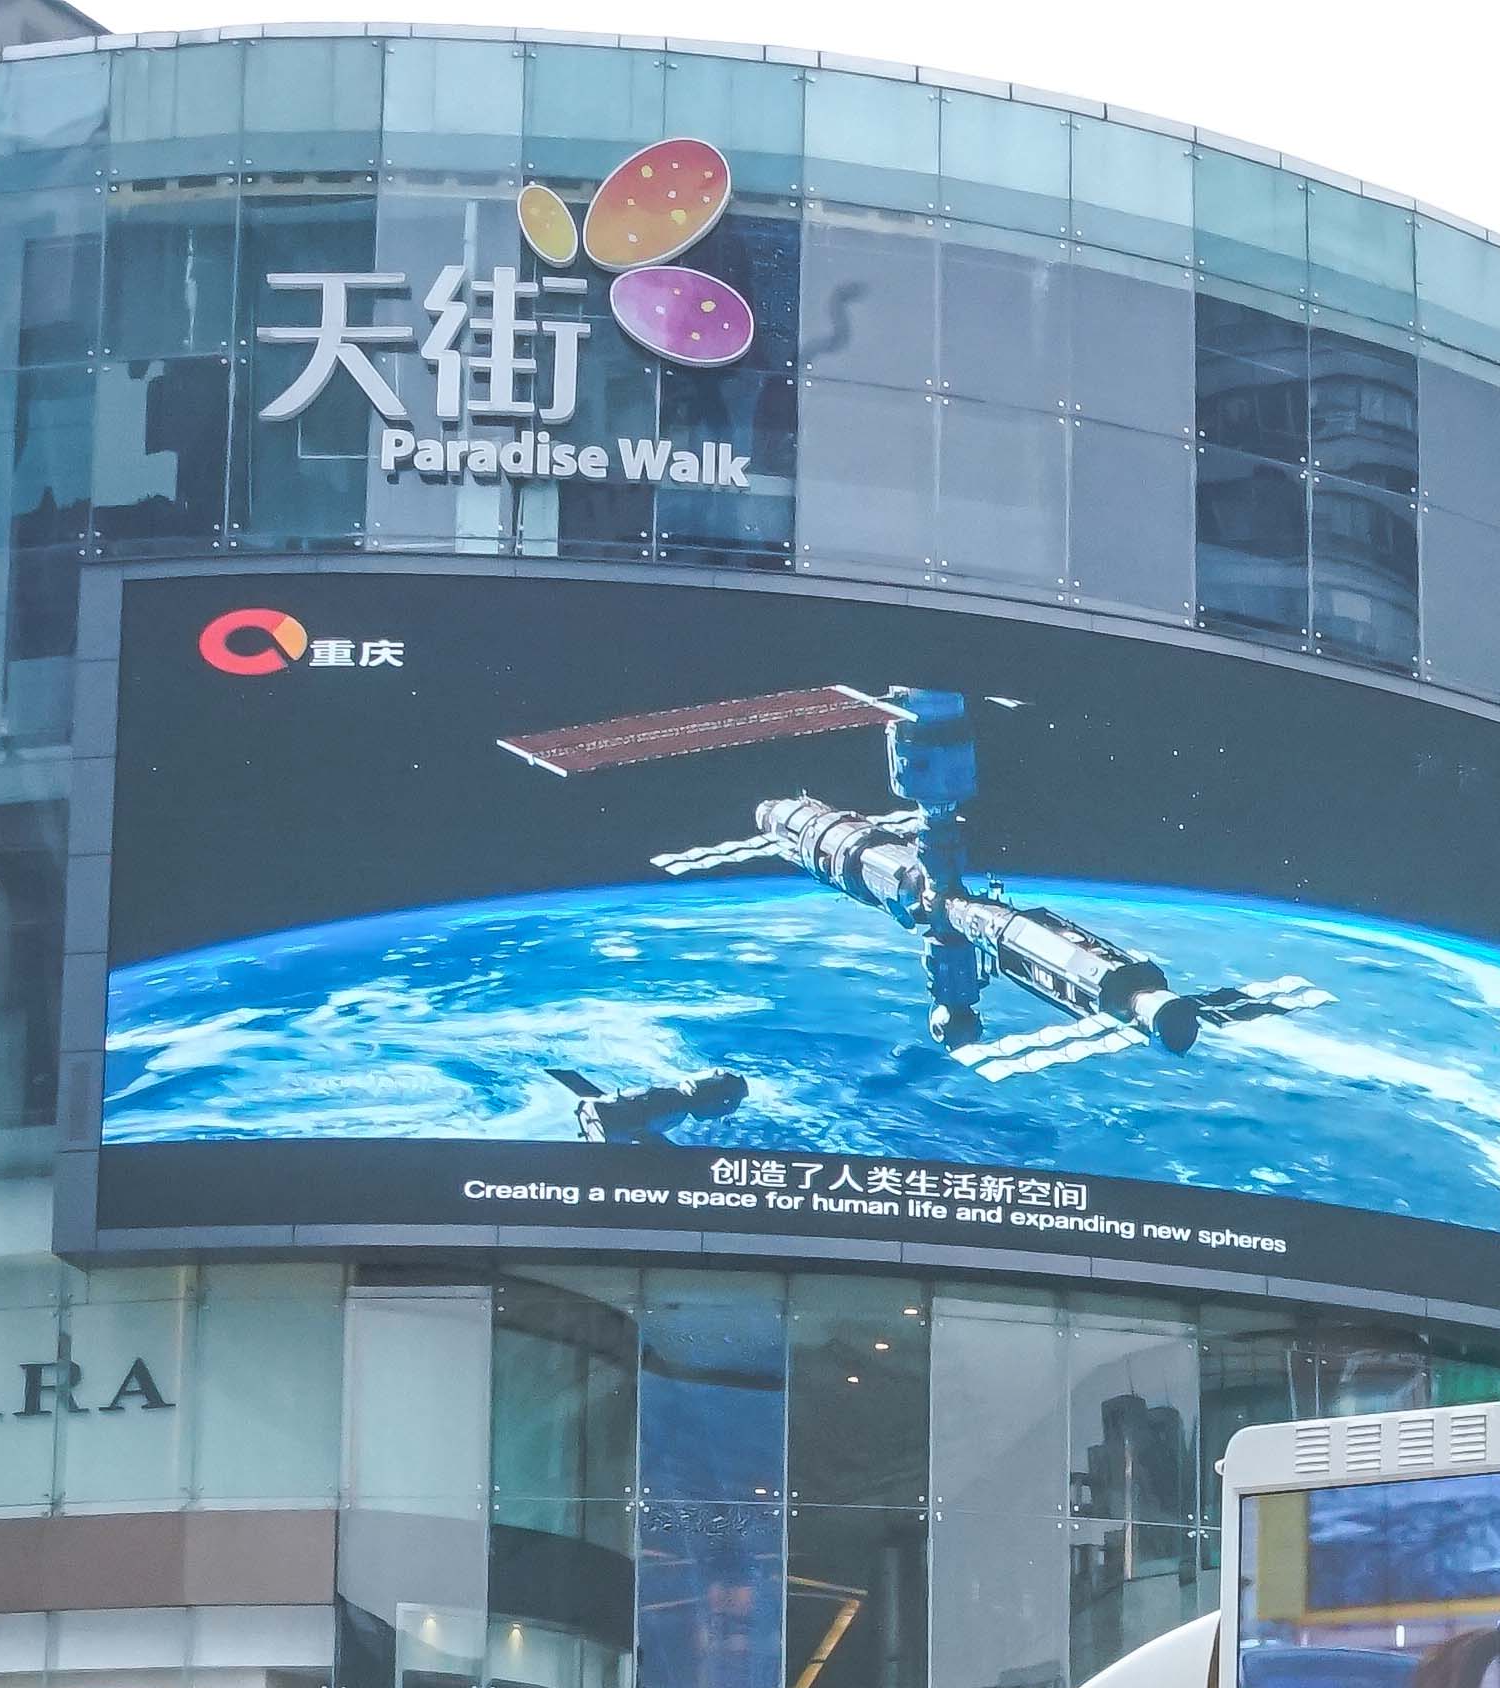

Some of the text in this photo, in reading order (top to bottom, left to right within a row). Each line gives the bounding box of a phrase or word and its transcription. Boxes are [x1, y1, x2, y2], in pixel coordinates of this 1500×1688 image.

[256, 264, 592, 425] 天街
[380, 428, 753, 488] Paradise Walk
[309, 639, 405, 669] 重庆
[710, 1156, 1088, 1211] 创造了人类生活新空间
[463, 1179, 1287, 1254] Creating a new space for human life and expanding new spheres
